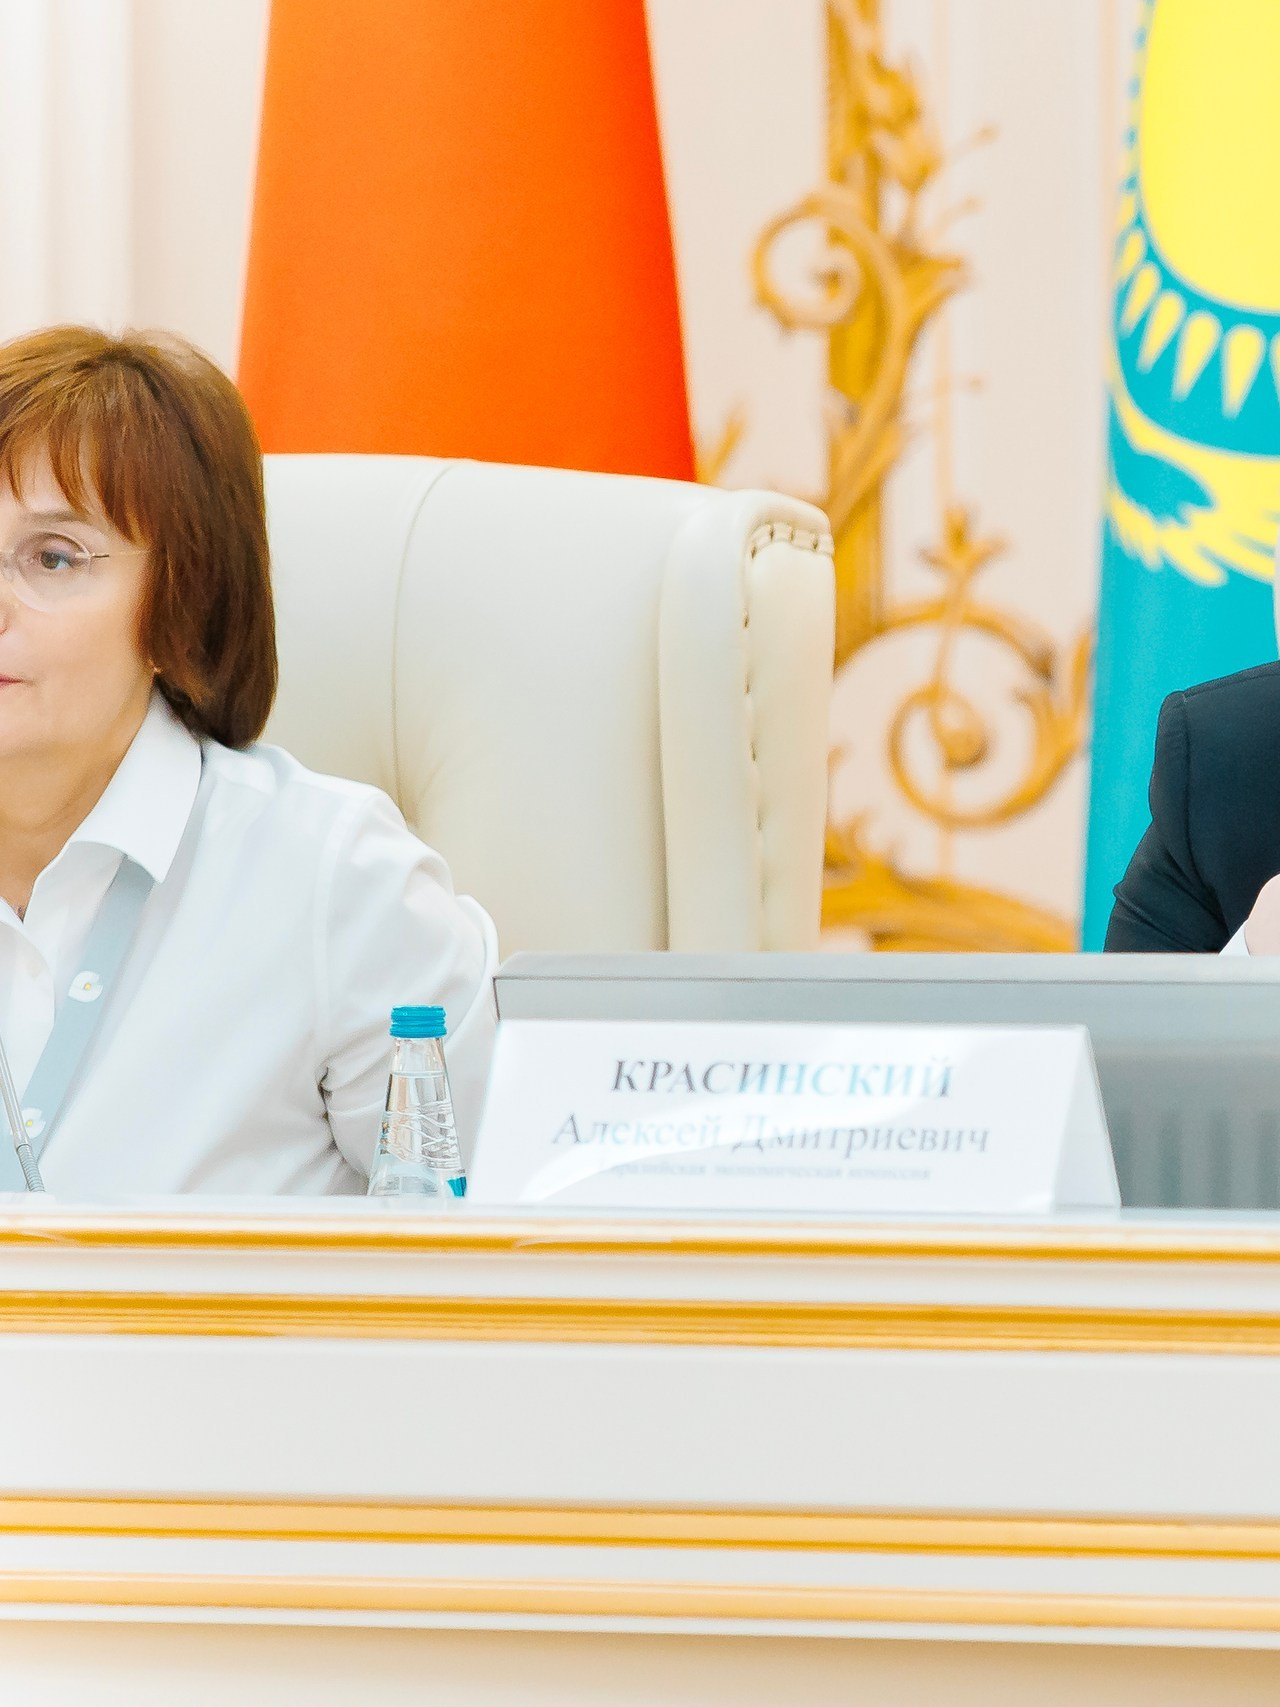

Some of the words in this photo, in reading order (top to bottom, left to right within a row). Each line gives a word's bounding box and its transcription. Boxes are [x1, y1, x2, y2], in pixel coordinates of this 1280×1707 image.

[610, 1058, 955, 1099] КРАСИНСКИЙ
[551, 1112, 723, 1147] Алексей
[732, 1114, 991, 1161] Дмитриевич
